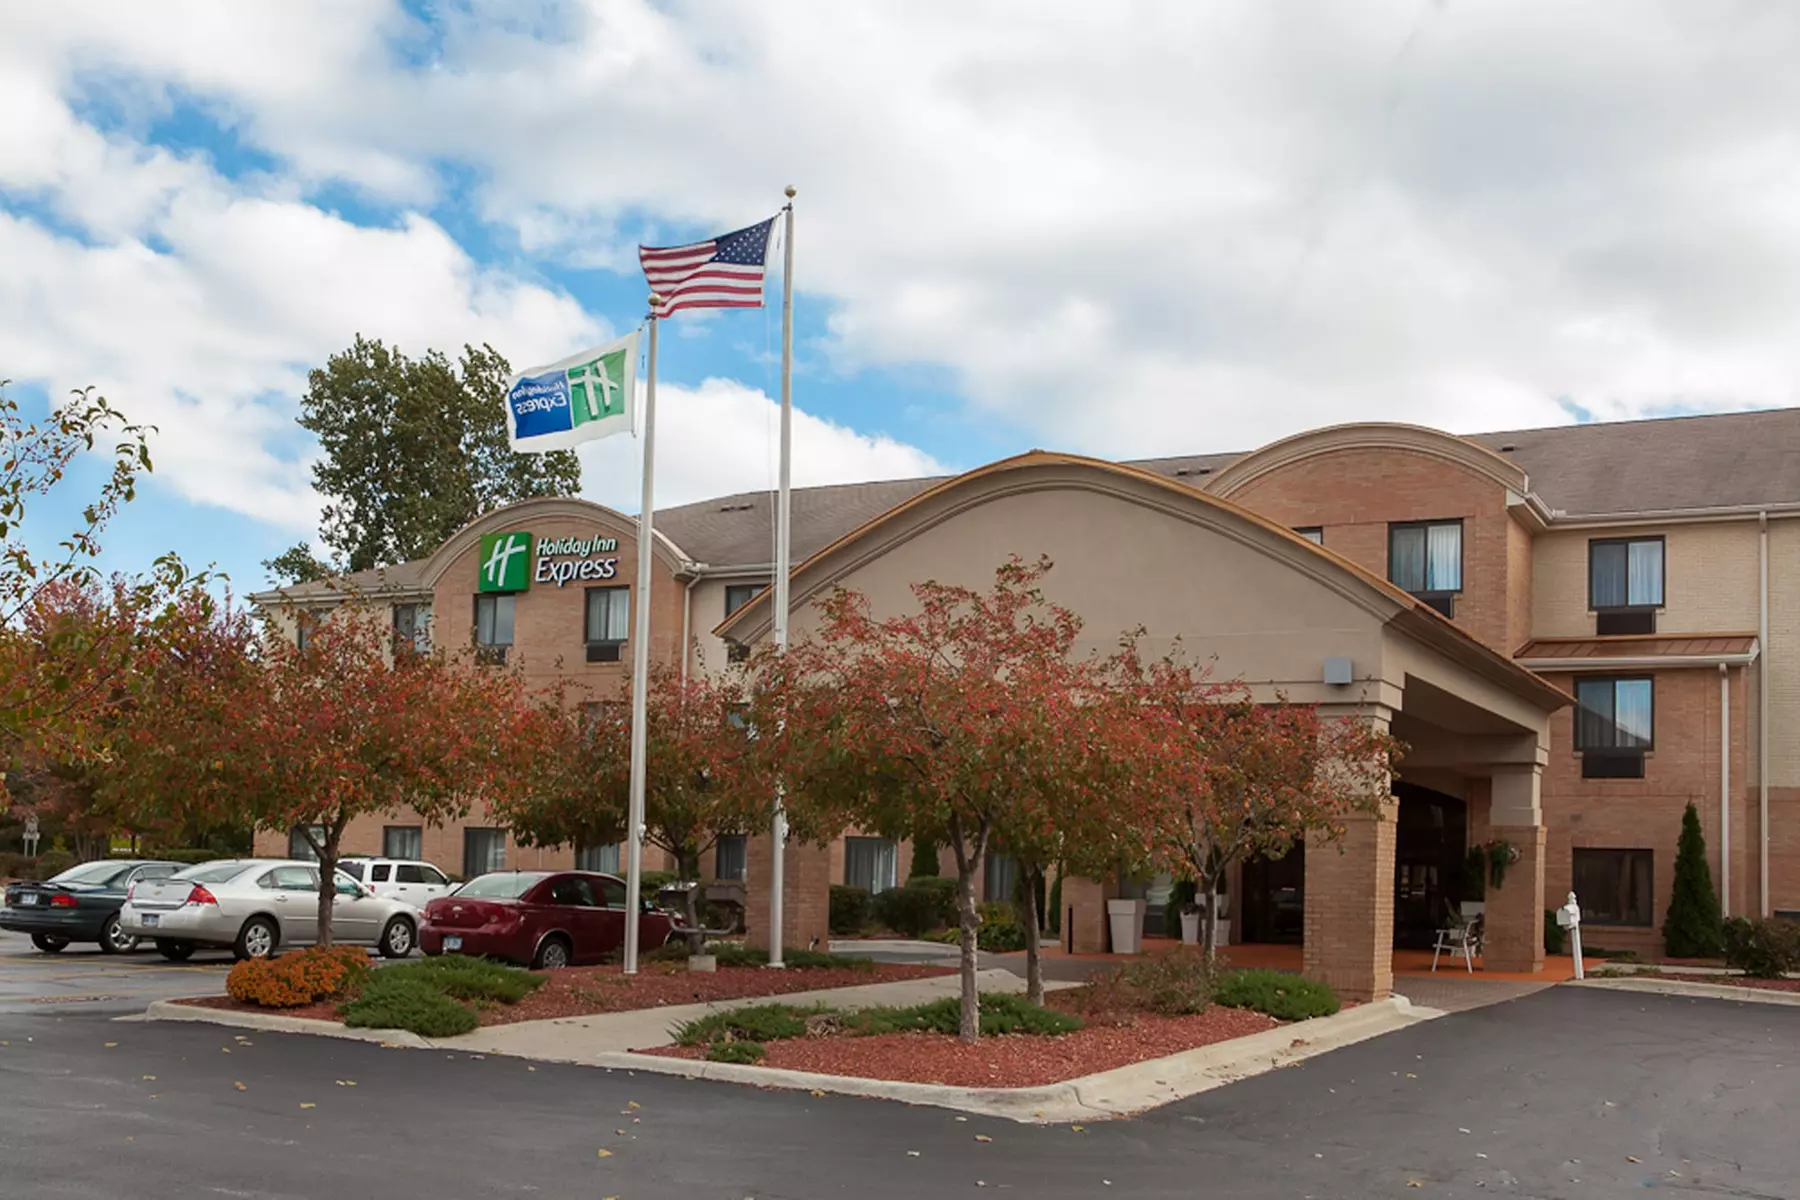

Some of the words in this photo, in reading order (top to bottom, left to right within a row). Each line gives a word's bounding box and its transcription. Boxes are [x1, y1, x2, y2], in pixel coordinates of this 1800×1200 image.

[536, 537, 591, 558] Holiday
[592, 534, 616, 552] Inn
[535, 557, 616, 587] Express
